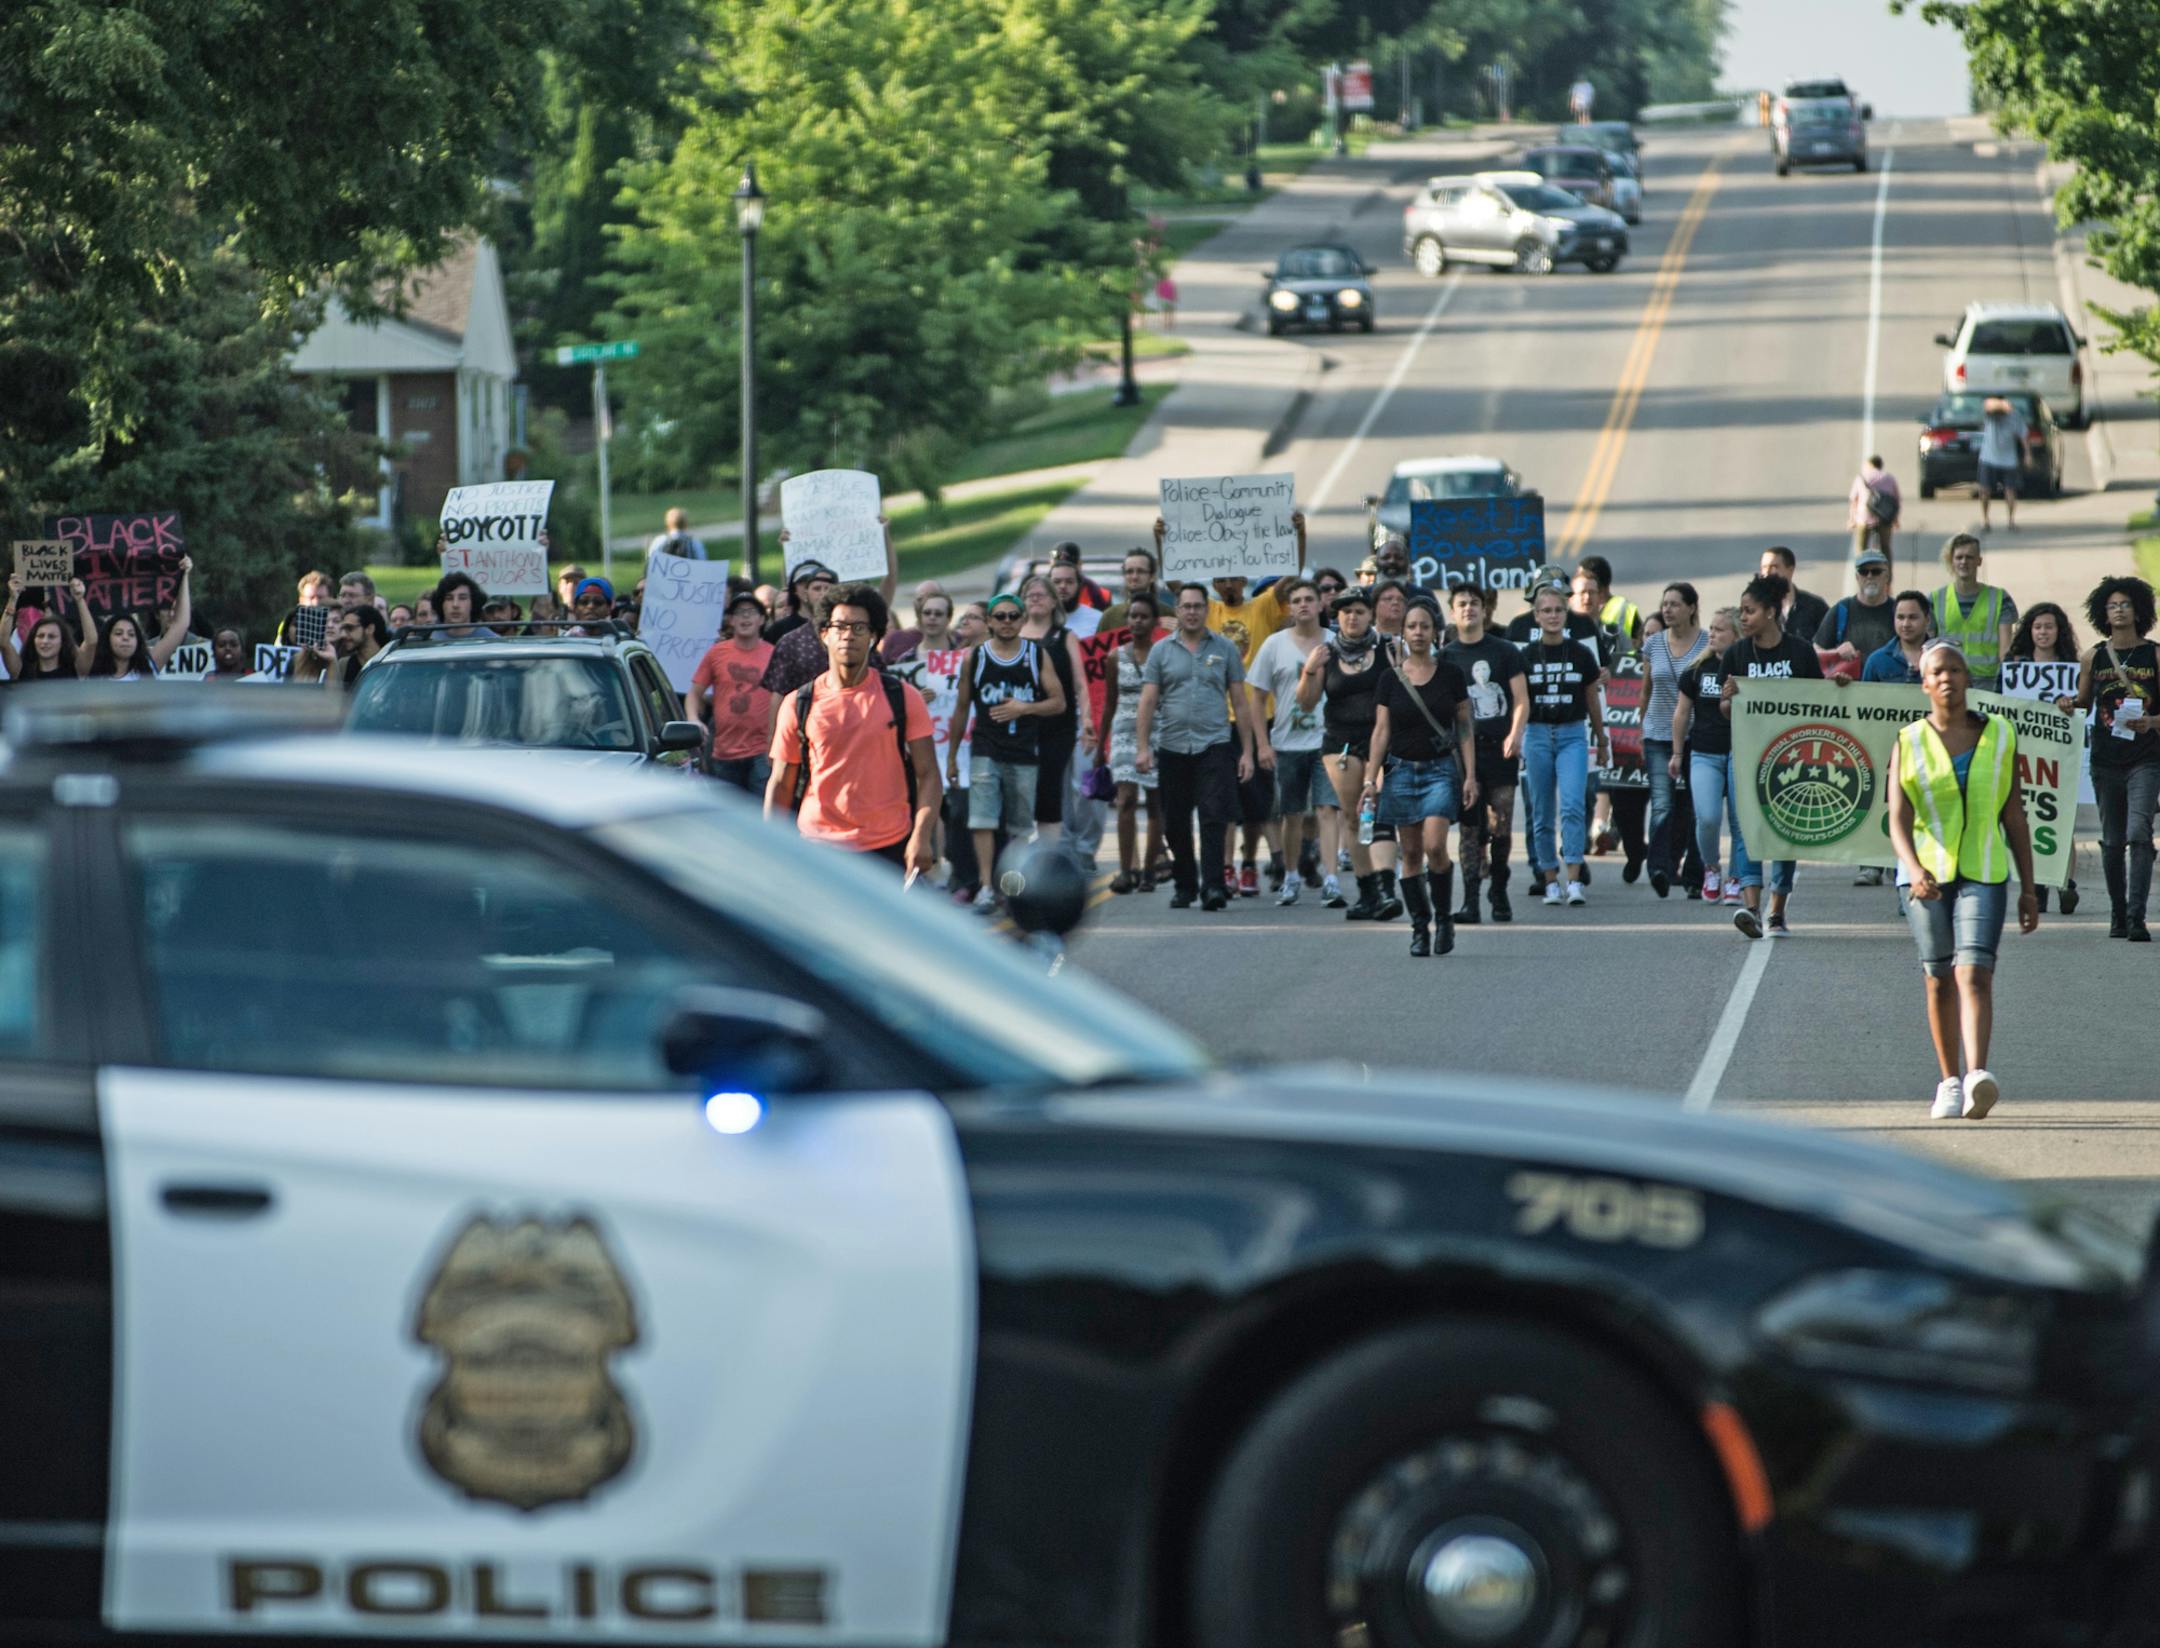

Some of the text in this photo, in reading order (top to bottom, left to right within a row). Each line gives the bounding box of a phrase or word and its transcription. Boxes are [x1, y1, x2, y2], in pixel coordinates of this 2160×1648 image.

[445, 502, 479, 515] NO
[57, 515, 184, 556] BLACK
[443, 514, 542, 544] BOYCOTT
[22, 544, 68, 557] BLACK
[80, 543, 182, 579] IVES
[30, 559, 67, 571] LIVES
[651, 556, 690, 578] NO
[1412, 556, 1537, 591] Philand
[643, 606, 677, 631] NO
[655, 634, 705, 659] PROF
[1748, 660, 1793, 678] BLACK
[1746, 701, 1932, 723] INDUSTRIAL WORKE
[1977, 702, 2070, 730] TWIN CITIES
[2016, 722, 2073, 744] WORLD
[1790, 728, 1835, 741] WORKERS
[1836, 734, 1850, 745] OF
[1858, 758, 1872, 792] WORLD
[227, 1556, 832, 1628] POLICE
